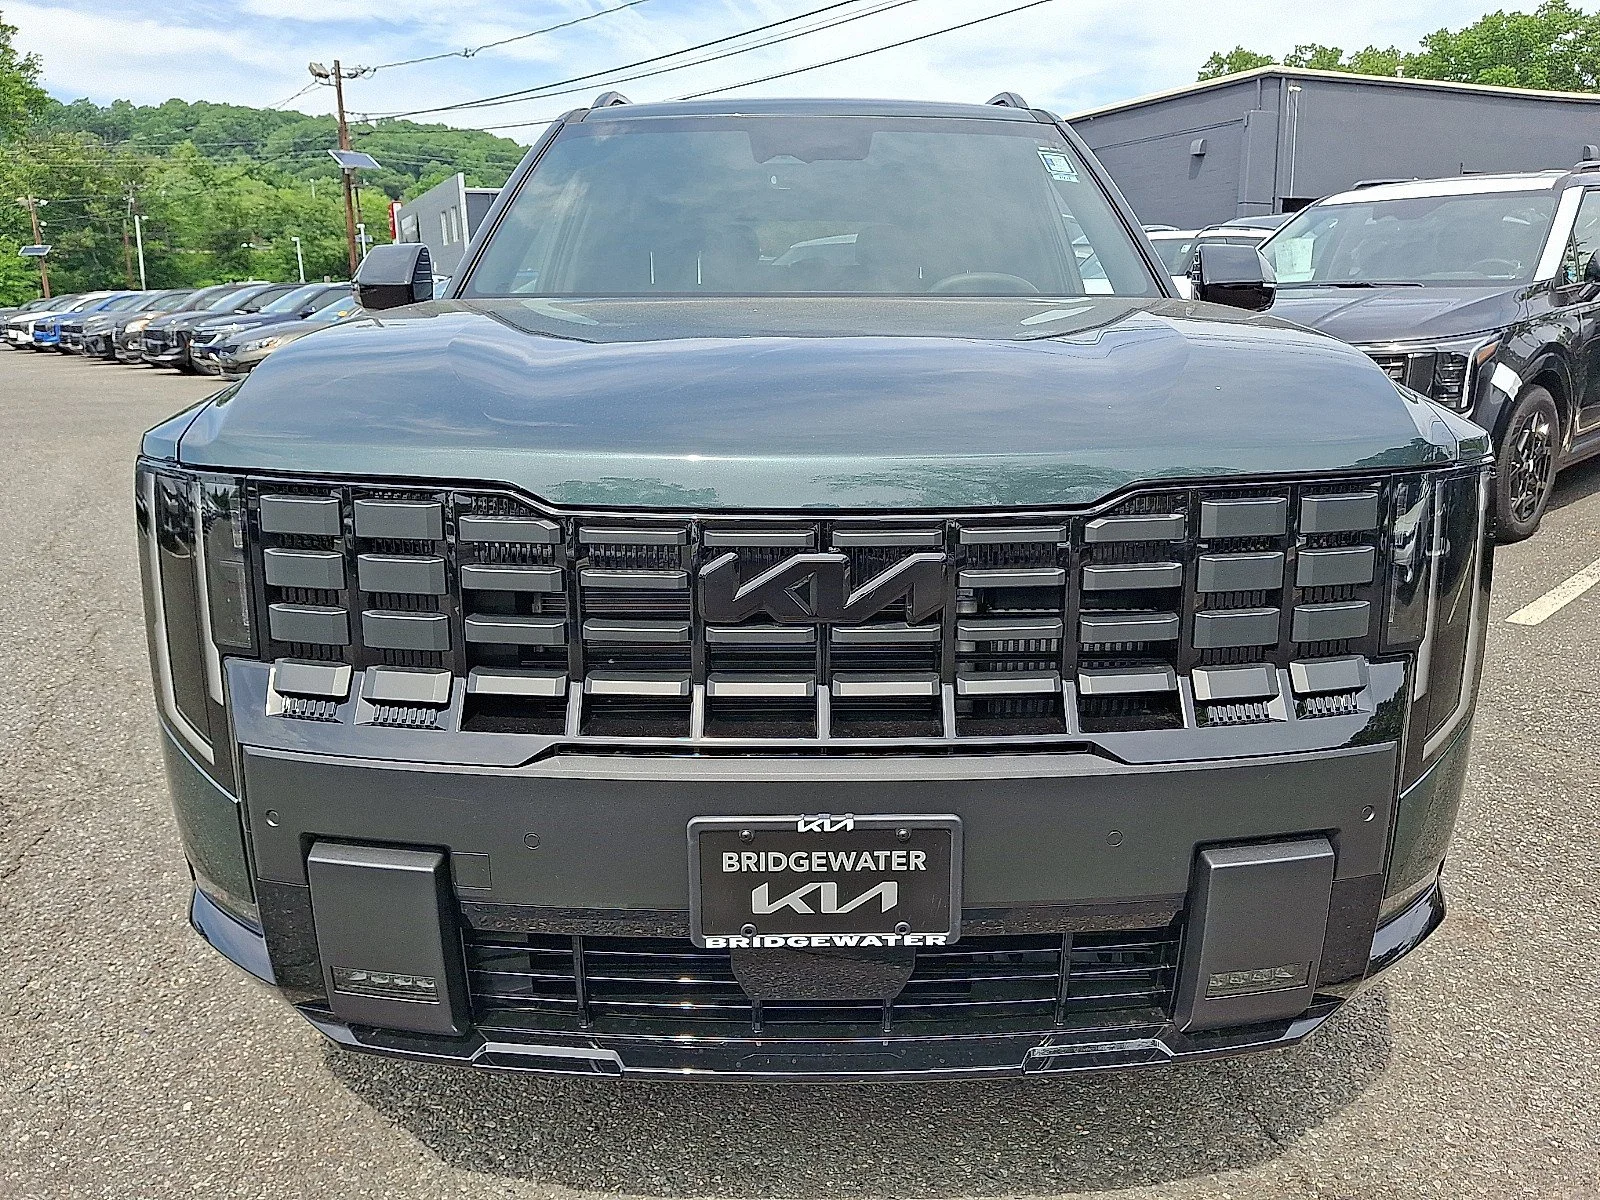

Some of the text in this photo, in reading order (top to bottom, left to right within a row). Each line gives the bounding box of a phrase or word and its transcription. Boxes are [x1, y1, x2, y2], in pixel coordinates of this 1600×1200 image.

[722, 851, 927, 872] BRIDGEWATER
[752, 881, 898, 914] KIA
[705, 934, 947, 949] BRIDGEWATER
